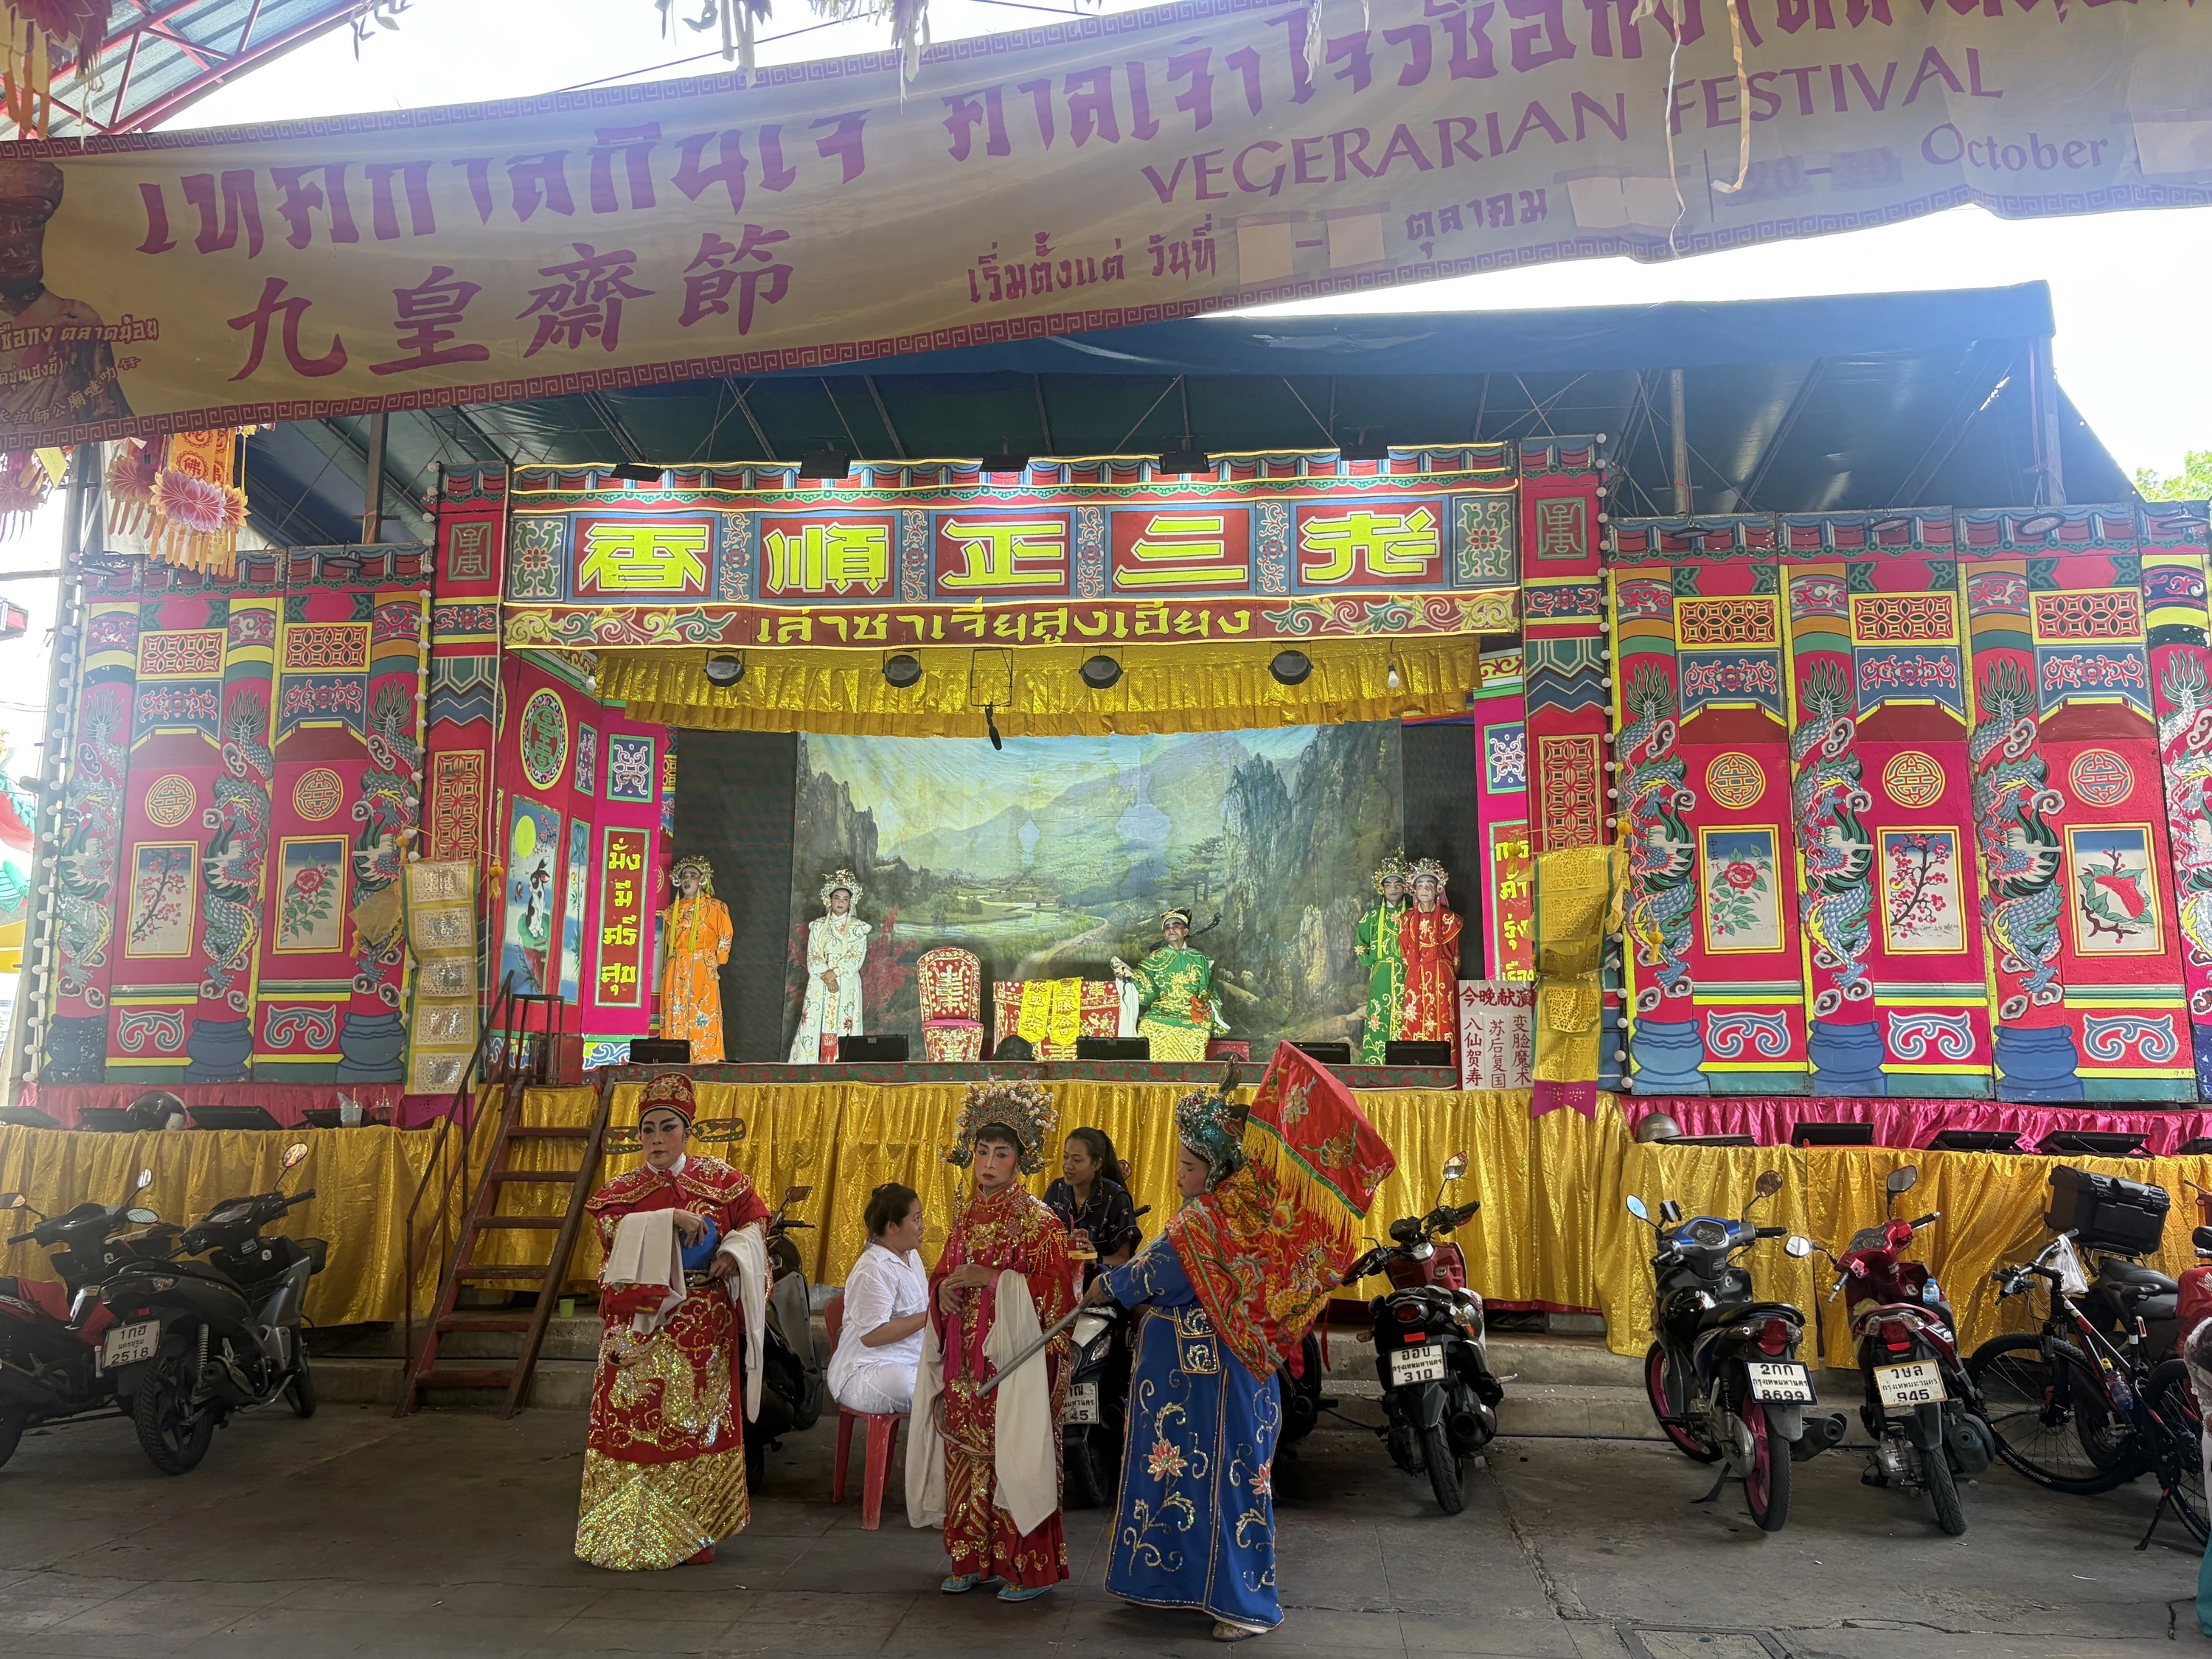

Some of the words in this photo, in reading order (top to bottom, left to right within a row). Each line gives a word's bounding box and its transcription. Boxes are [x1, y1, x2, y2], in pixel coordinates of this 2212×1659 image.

[1141, 90, 1628, 204] VEGERARIAN
[1661, 46, 2004, 137] FESTIVAL
[1921, 122, 2109, 172] October
[136, 108, 872, 260] เทศกาลกินเจ
[968, 232, 1125, 303] เริ่มตั้งแต่
[1147, 213, 1217, 282] วันที่
[1405, 187, 1548, 259] ตุลาคม
[1464, 1017, 1484, 1087] 八仙贺寿
[1487, 1019, 1508, 1088] 苏后复国
[1512, 1015, 1532, 1085] 变脸魔术
[111, 1346, 149, 1364] 2518
[1392, 1358, 1442, 1373] กรุงเทพมหานคร
[1760, 1363, 1794, 1376] 2กก
[1404, 1368, 1433, 1382] 310
[1753, 1378, 1809, 1388] กรุงเทพมหานคร
[1882, 1378, 1938, 1392] กรุงเทพมหานคร
[1761, 1389, 1805, 1400] 8699
[1896, 1388, 1930, 1402] 945
